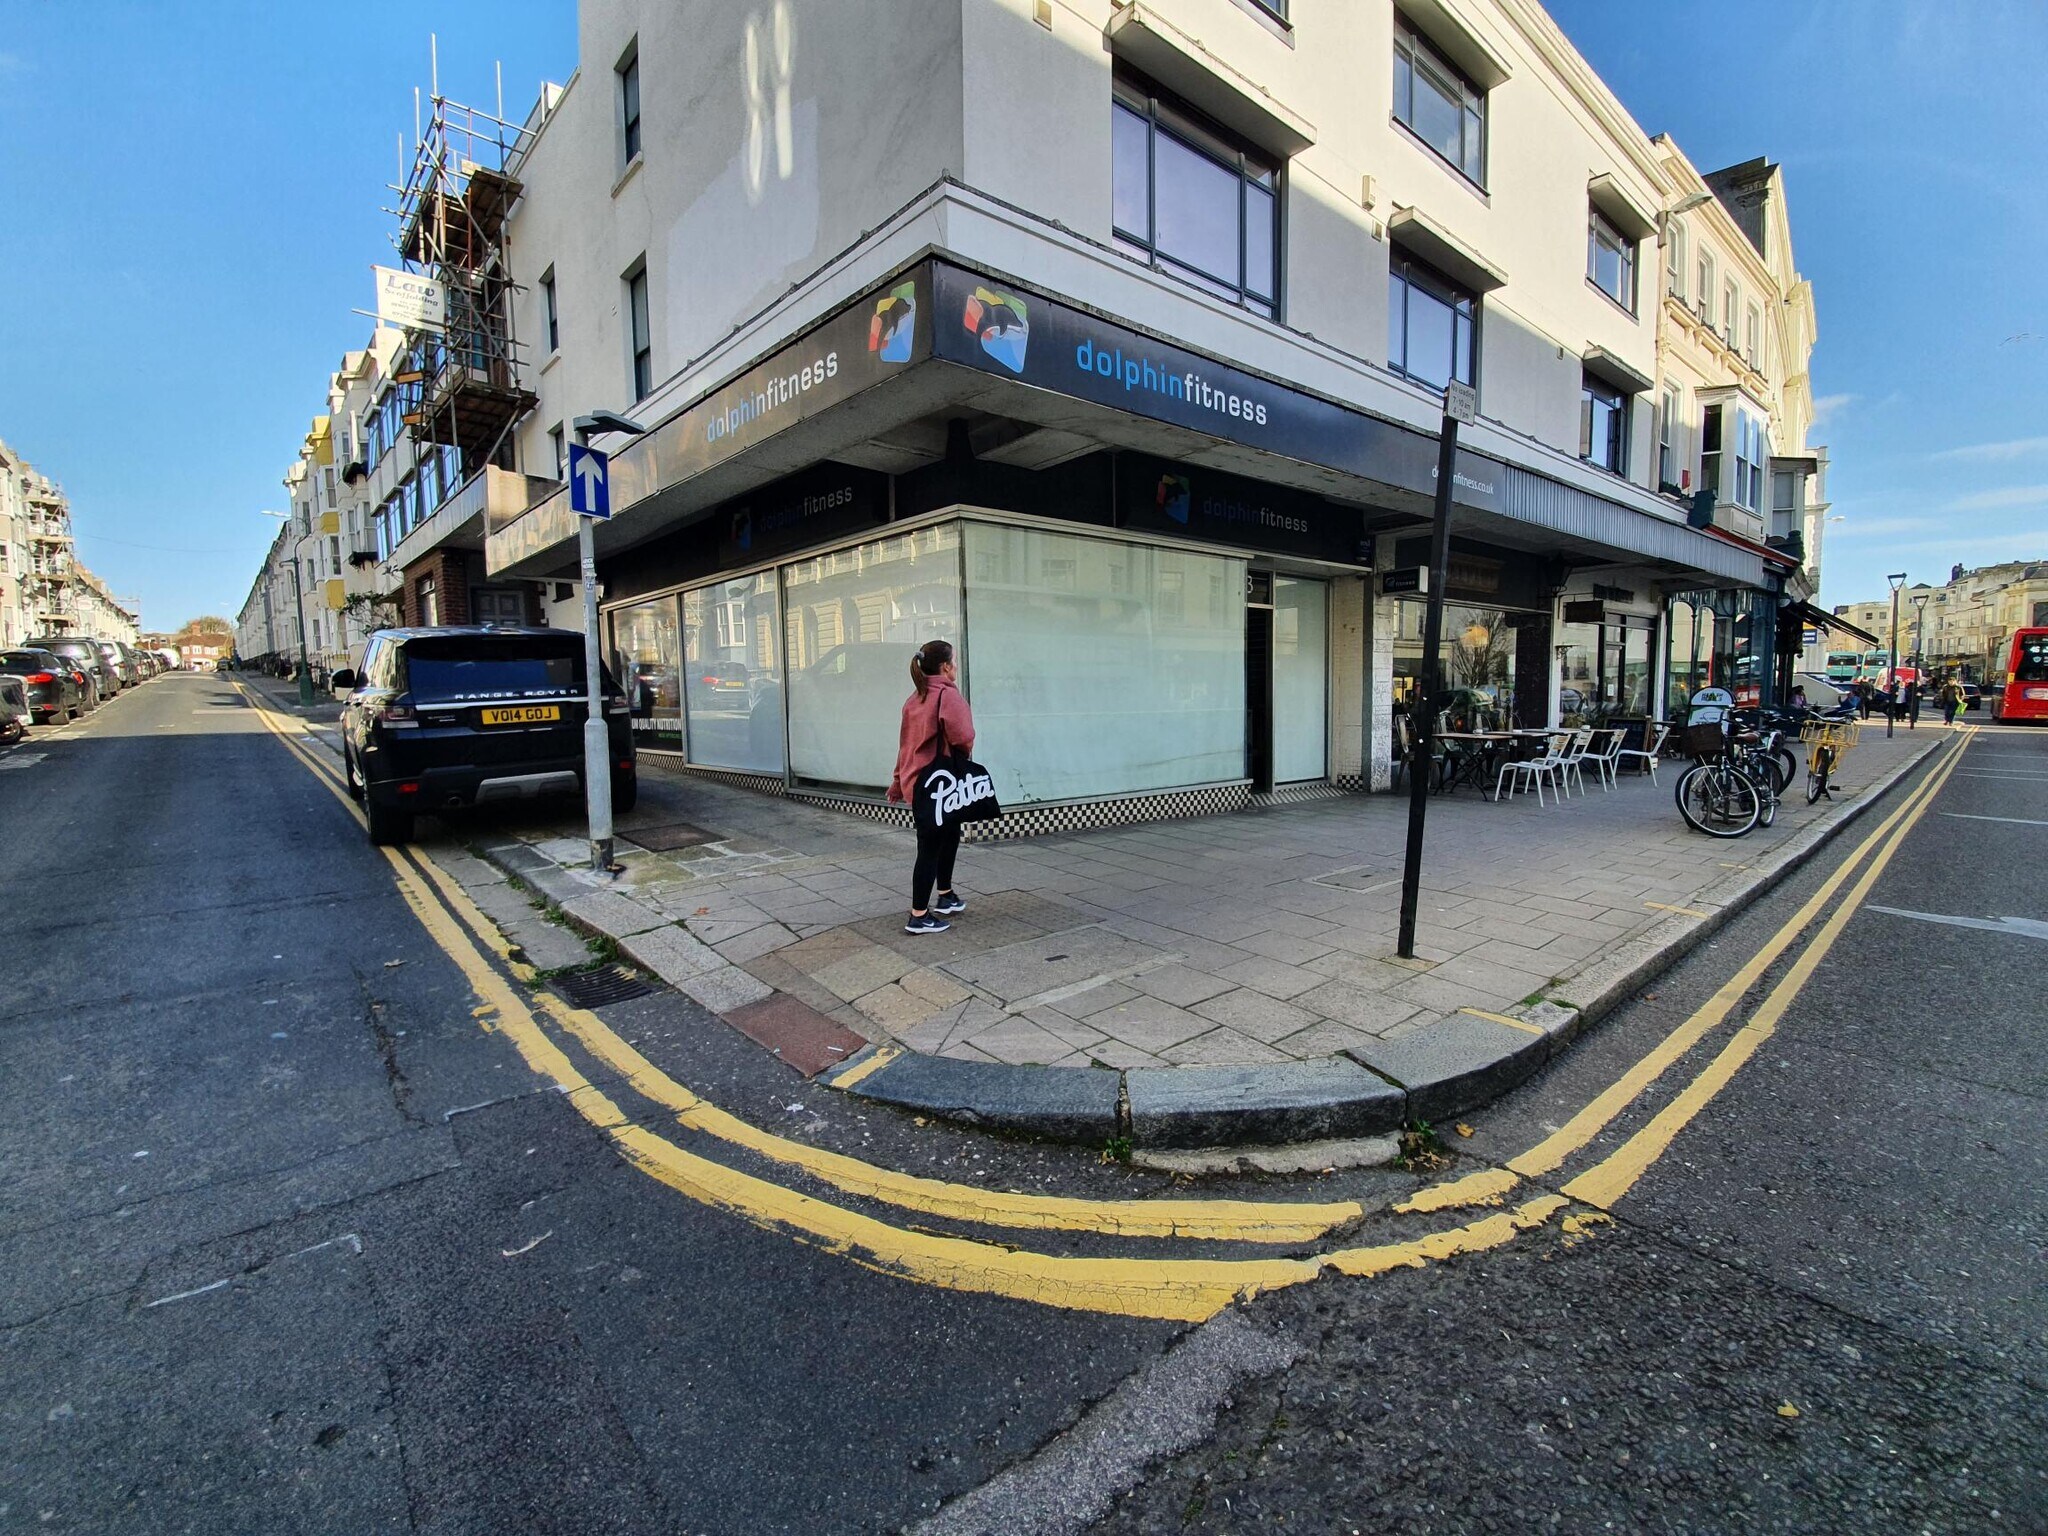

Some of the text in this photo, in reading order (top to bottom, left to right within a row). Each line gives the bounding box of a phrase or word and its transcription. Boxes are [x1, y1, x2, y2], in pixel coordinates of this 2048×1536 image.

[707, 352, 838, 443] dolphinfitness
[1076, 339, 1267, 426] dolphinfitness
[1203, 497, 1308, 533] dolphinfitness
[455, 689, 578, 700] RANGE ROVER
[639, 718, 657, 731] QUALITY
[657, 718, 683, 731] NUTRITION
[924, 769, 995, 827] Patta
